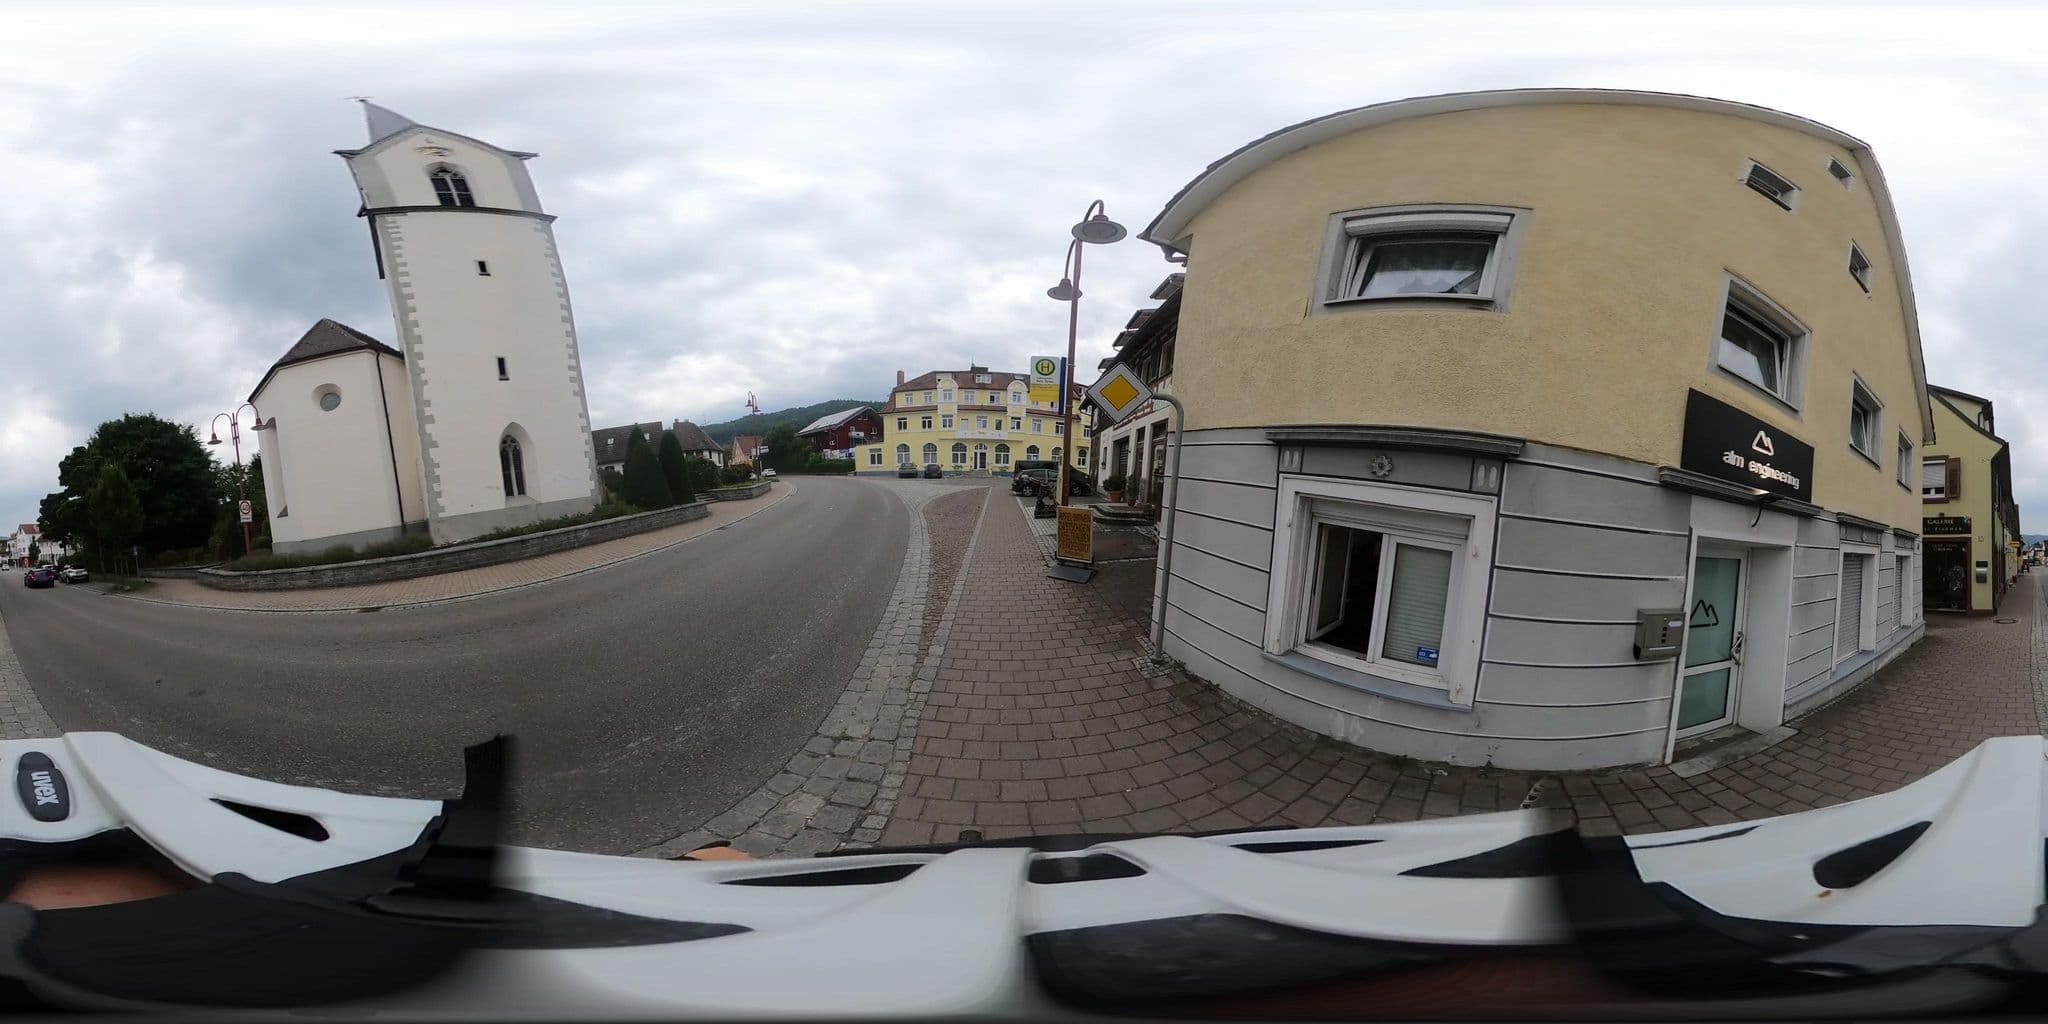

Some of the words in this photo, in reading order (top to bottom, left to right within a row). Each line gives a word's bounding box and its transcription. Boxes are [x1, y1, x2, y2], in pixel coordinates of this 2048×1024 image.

[1041, 362, 1050, 372] H
[1722, 450, 1745, 469] alm
[1748, 460, 1800, 490] engineering
[31, 771, 60, 806] uvex
